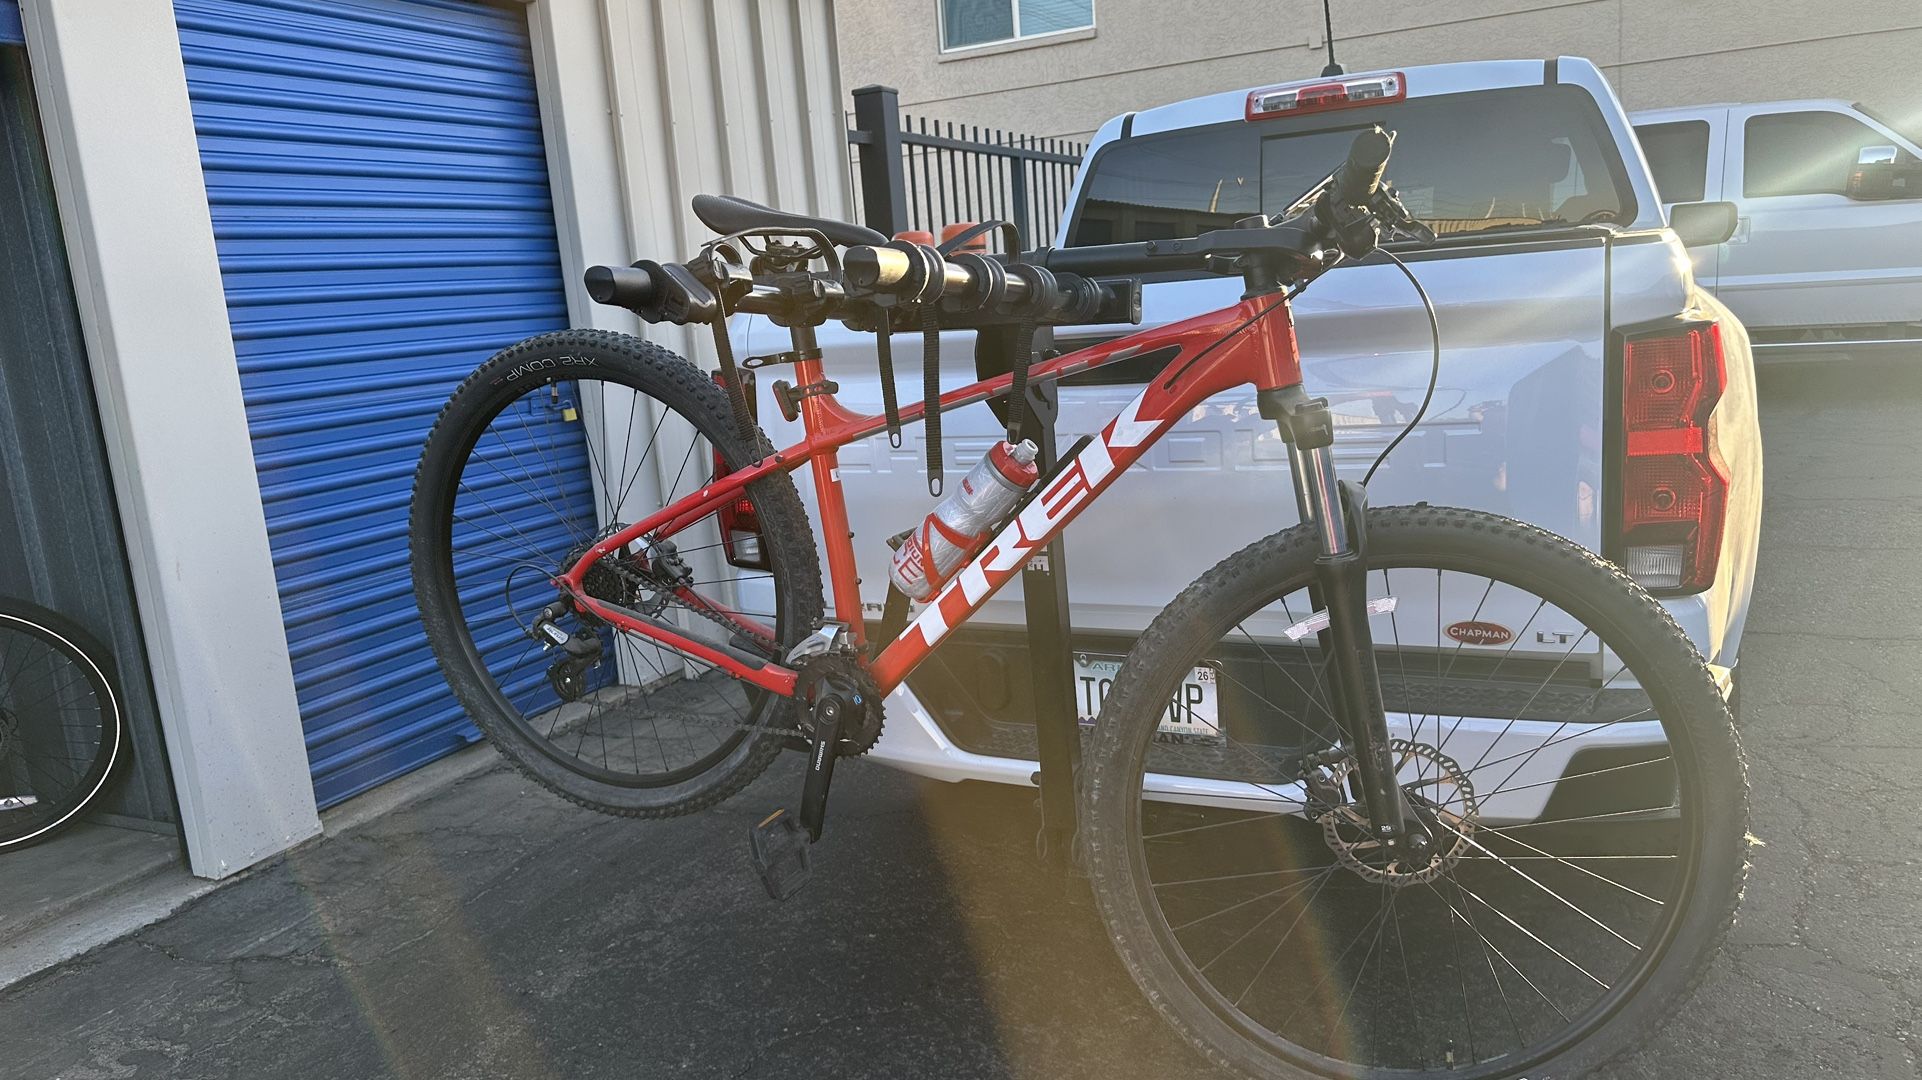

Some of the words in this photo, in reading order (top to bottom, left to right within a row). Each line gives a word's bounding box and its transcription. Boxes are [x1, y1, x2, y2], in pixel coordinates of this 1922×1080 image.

[560, 355, 599, 367] XR2
[506, 357, 556, 382] COMP
[898, 383, 1165, 647] TREK
[1449, 626, 1510, 640] CHAPMAN
[1537, 631, 1575, 643] LT
[1197, 671, 1209, 681] 26
[815, 740, 826, 771] SHIMANO
